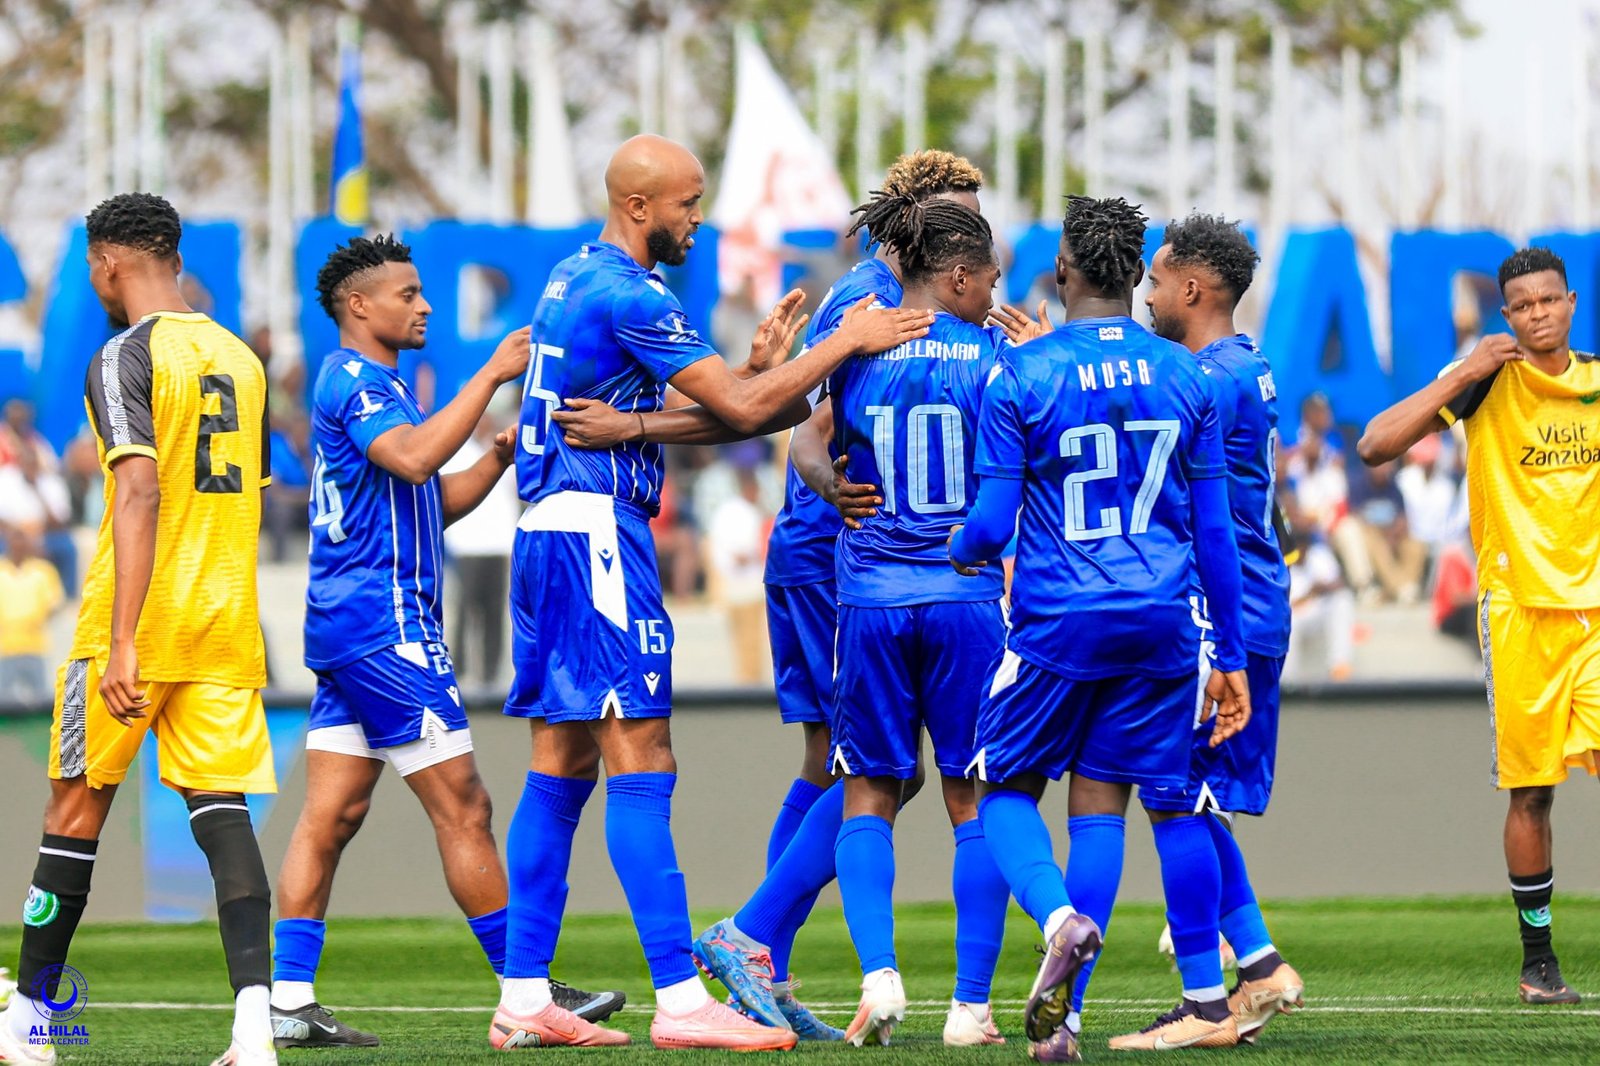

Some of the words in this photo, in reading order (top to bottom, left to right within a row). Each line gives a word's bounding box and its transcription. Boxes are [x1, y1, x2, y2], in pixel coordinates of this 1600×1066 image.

[1077, 359, 1151, 391] MUSA
[194, 374, 242, 493] 2
[865, 404, 965, 515] 10
[1537, 422, 1588, 444] Visit
[1059, 420, 1181, 541] 27
[634, 619, 666, 654] 15
